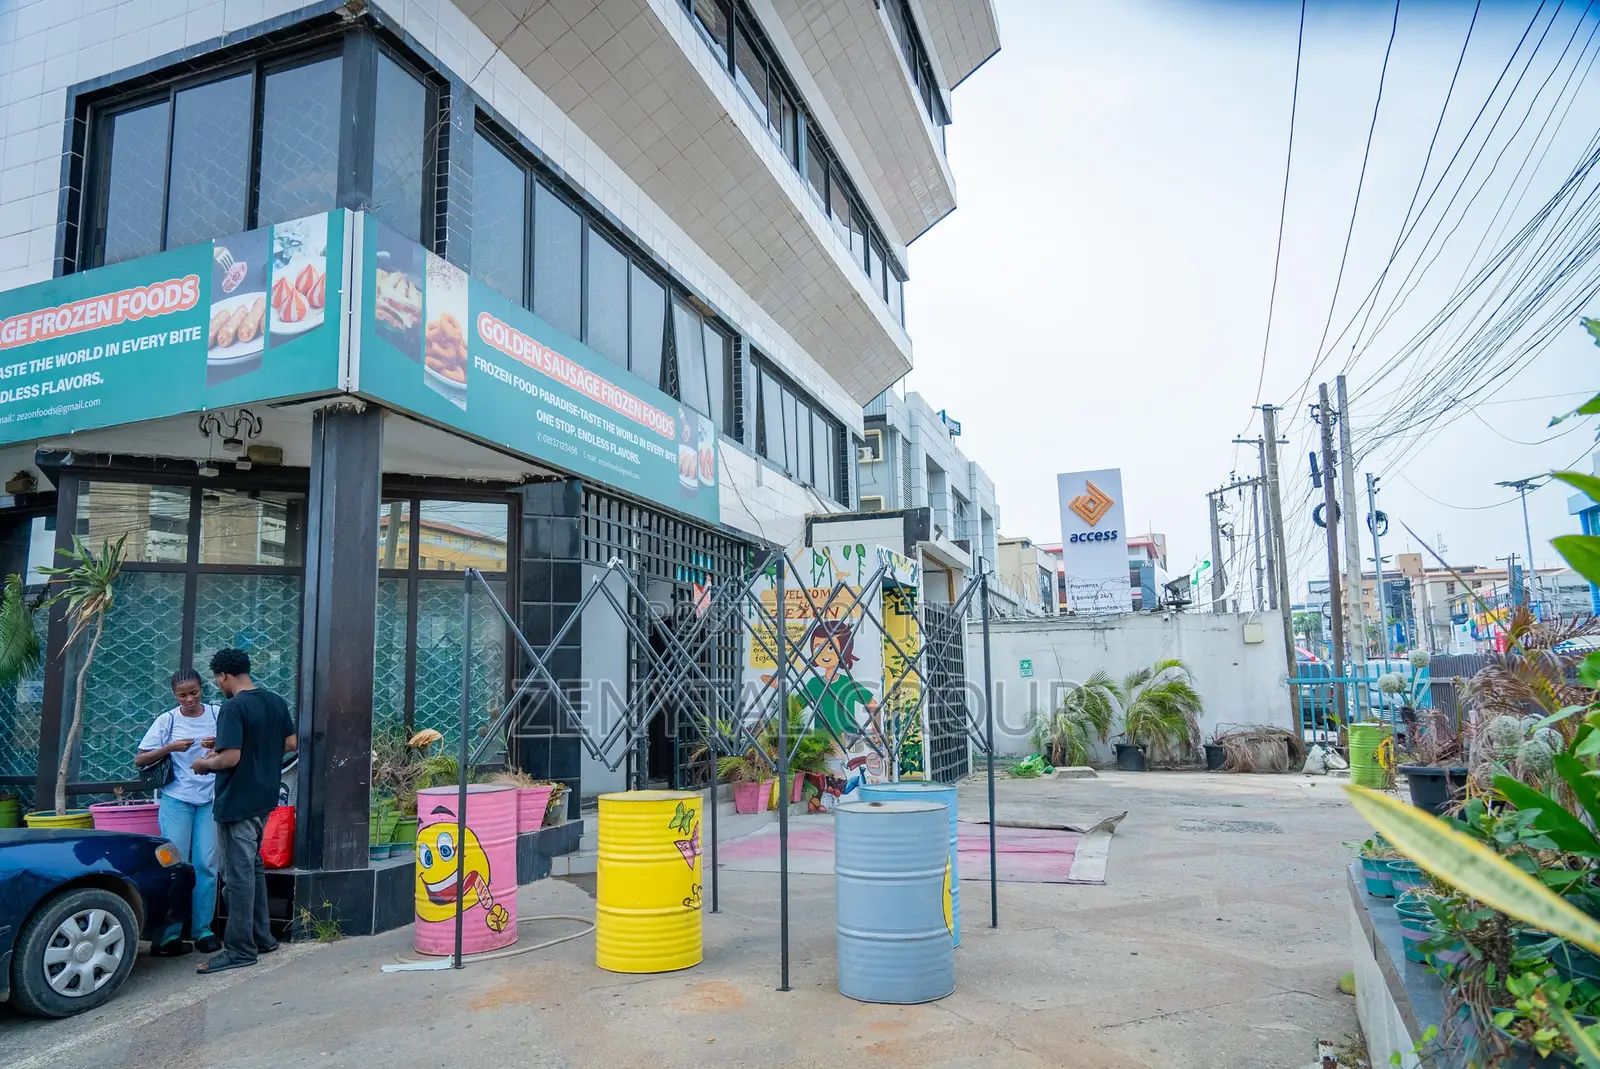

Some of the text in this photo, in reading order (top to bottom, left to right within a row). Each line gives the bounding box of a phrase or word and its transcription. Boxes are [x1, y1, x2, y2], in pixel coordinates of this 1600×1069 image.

[0, 279, 196, 343] GE FROZEN FOODS
[29, 356, 54, 373] THE
[55, 346, 103, 368] WORLD
[105, 341, 120, 358] IN
[124, 332, 168, 354] EVERY
[169, 326, 202, 345] BITE
[41, 371, 104, 396] FLAVORS.
[481, 317, 674, 436] GOLDEN SAUSAGE FROZEN FOODS
[16, 398, 101, 422] zezonfoods@gmail.com
[474, 355, 513, 385] FROZEN
[513, 375, 539, 397] FOOD
[602, 418, 616, 435] THE
[615, 425, 639, 445] WORLD
[639, 437, 647, 449] IN
[646, 440, 665, 459] EVERY
[664, 448, 677, 464] BITE
[536, 409, 641, 465] ONE STOP. ENDLESS FLAVORS.
[1070, 529, 1118, 543] access
